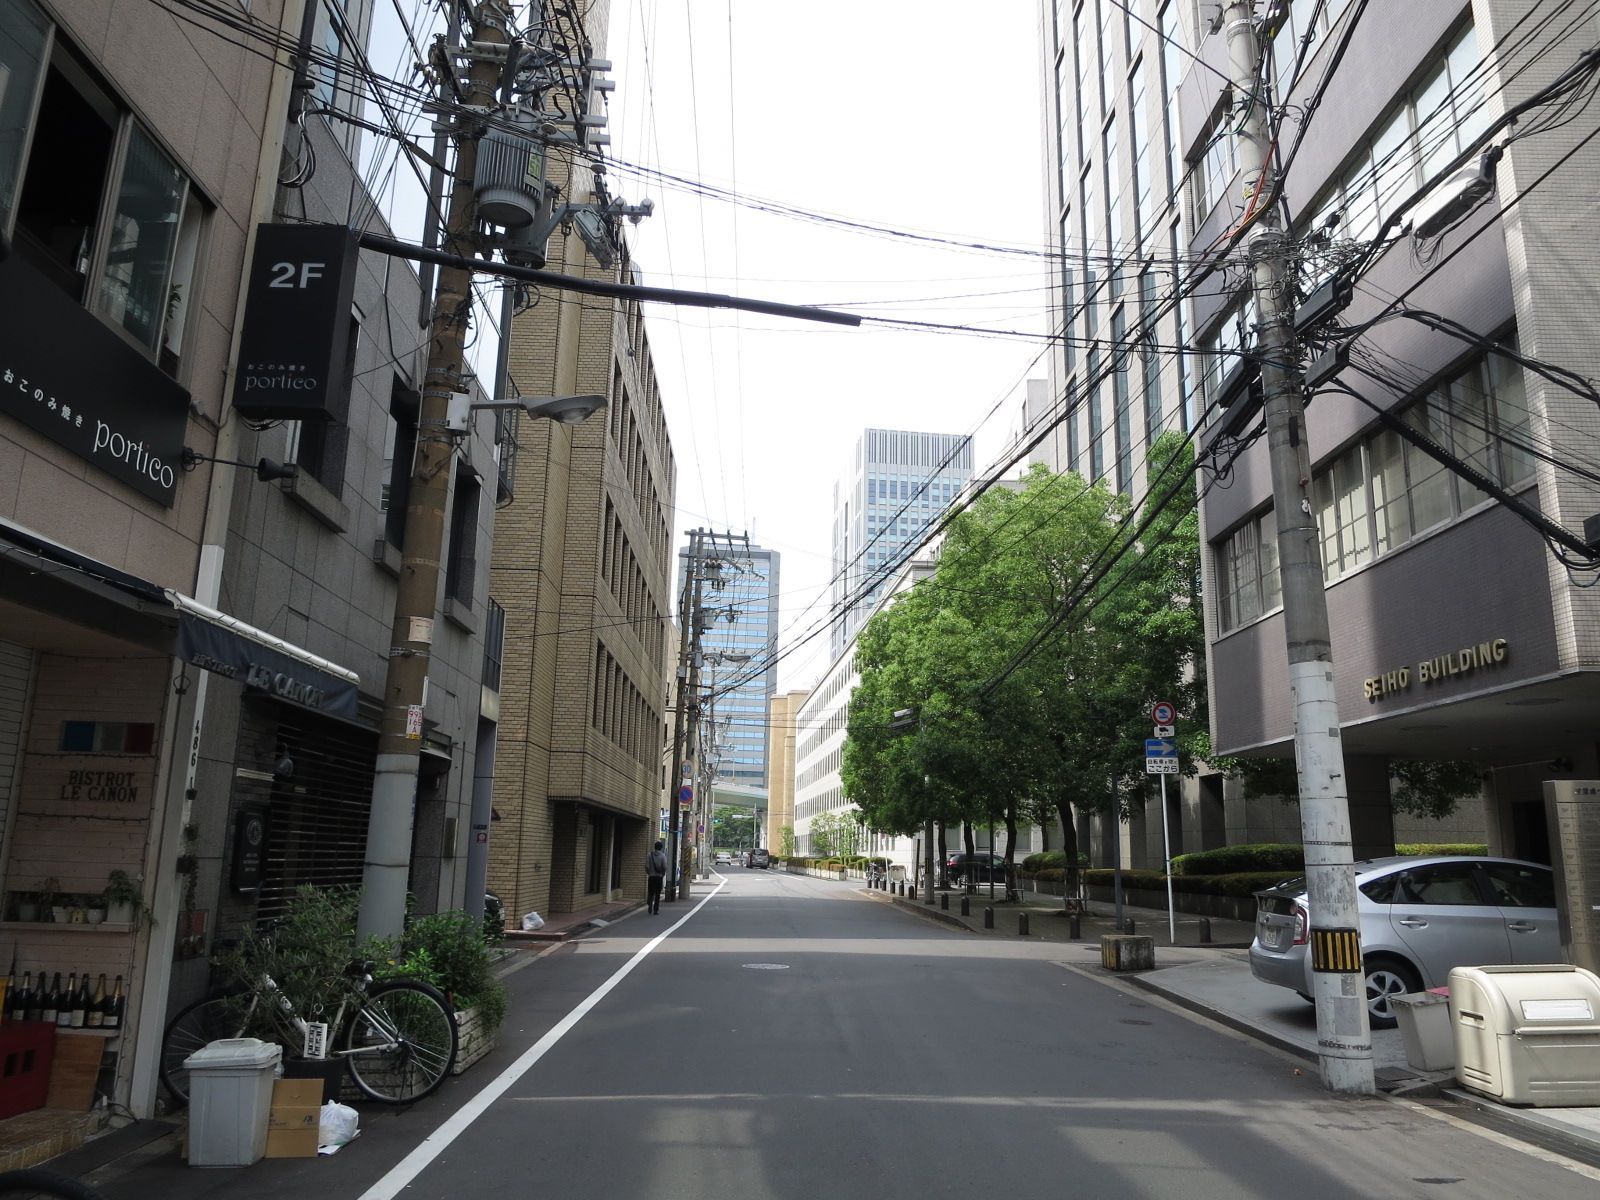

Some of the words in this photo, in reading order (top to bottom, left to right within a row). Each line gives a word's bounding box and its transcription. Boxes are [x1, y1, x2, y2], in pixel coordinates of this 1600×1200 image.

[269, 262, 326, 289] 2F
[3, 368, 84, 429] おこのみ焼き
[245, 373, 317, 391] portico
[92, 419, 174, 489] portico
[247, 662, 273, 691] LE
[273, 671, 326, 708] CANON
[1363, 665, 1410, 698] SEIHO
[1418, 638, 1508, 683] BUILDING
[61, 785, 82, 800] LE
[88, 786, 138, 802] CANON
[69, 771, 136, 787] BISTROT
